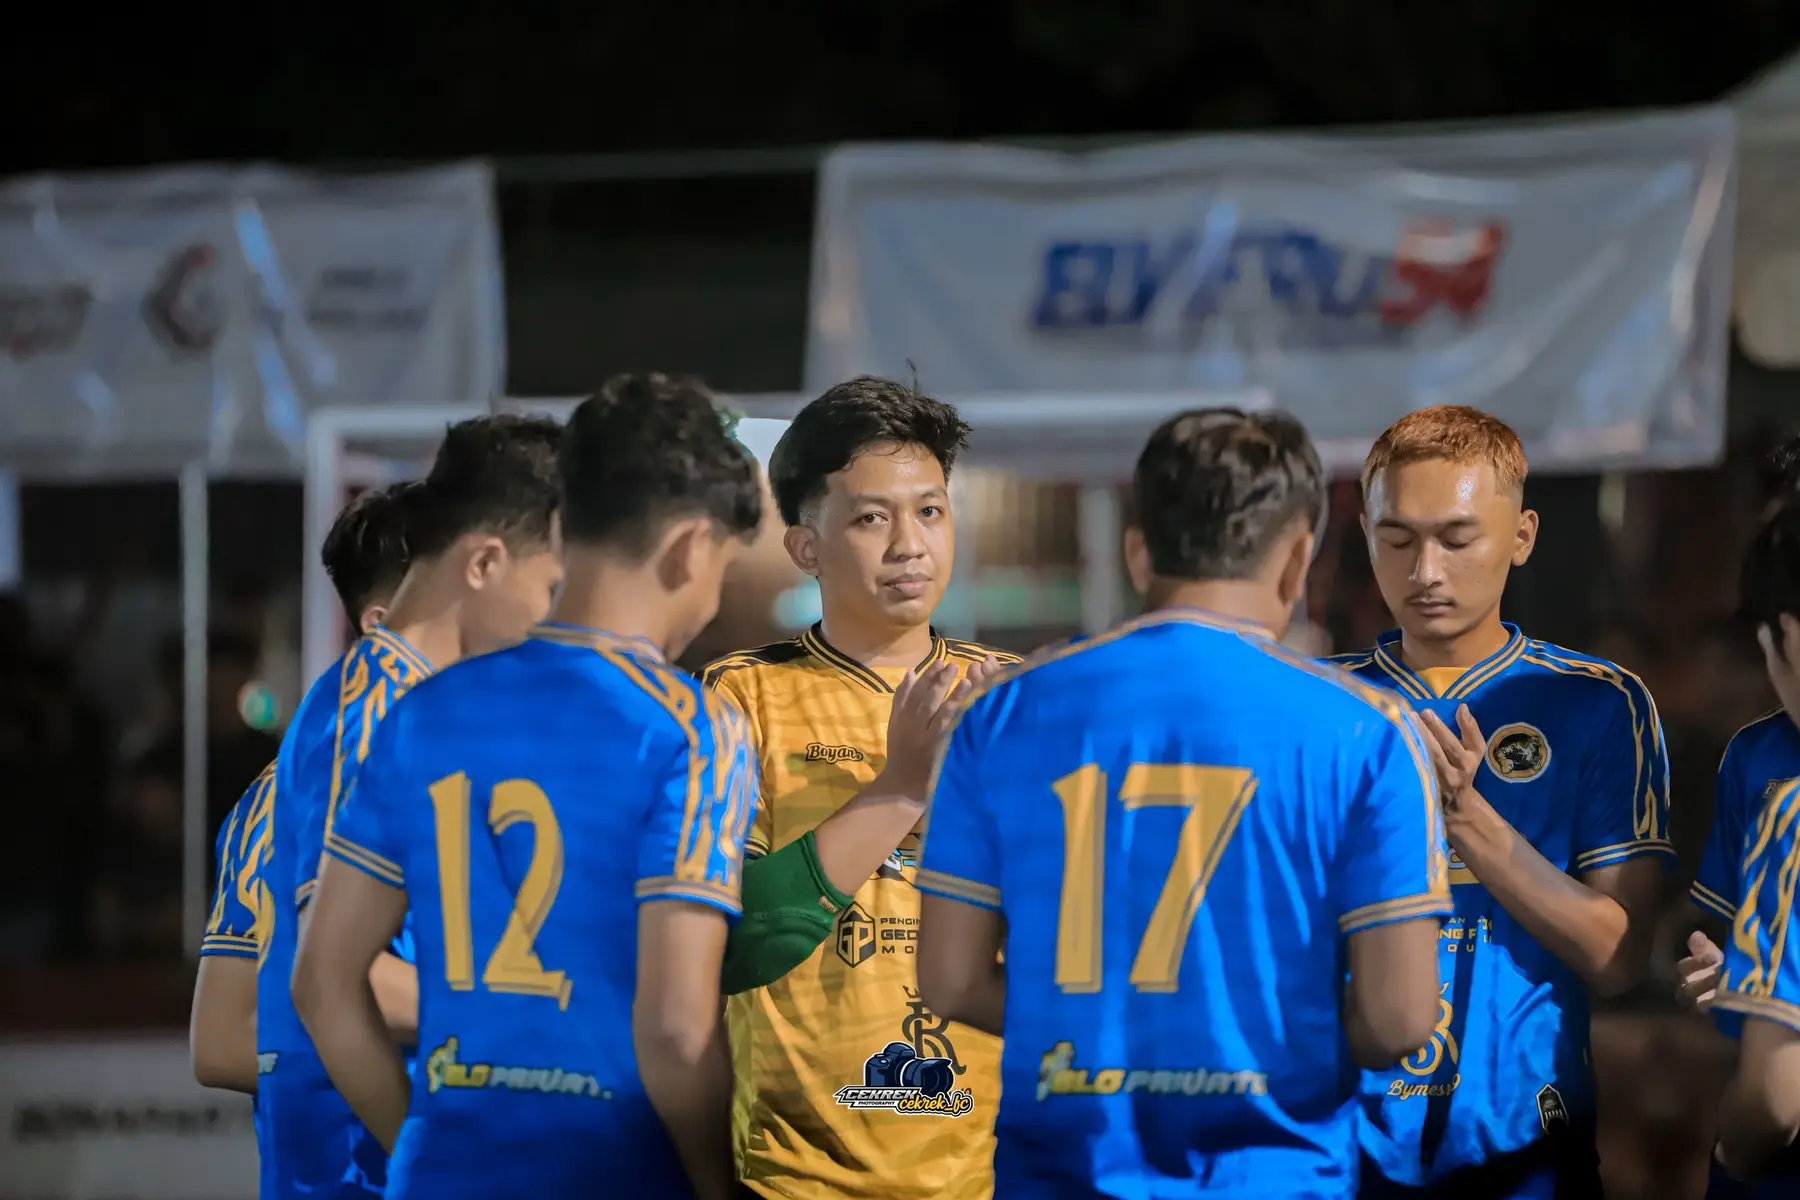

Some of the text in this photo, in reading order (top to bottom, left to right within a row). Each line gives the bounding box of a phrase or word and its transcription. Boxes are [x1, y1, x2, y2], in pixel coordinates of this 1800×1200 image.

[808, 744, 862, 761] Boyan
[427, 769, 573, 1012] 12
[880, 917, 920, 925] PENGIN
[1051, 761, 1260, 994] 17
